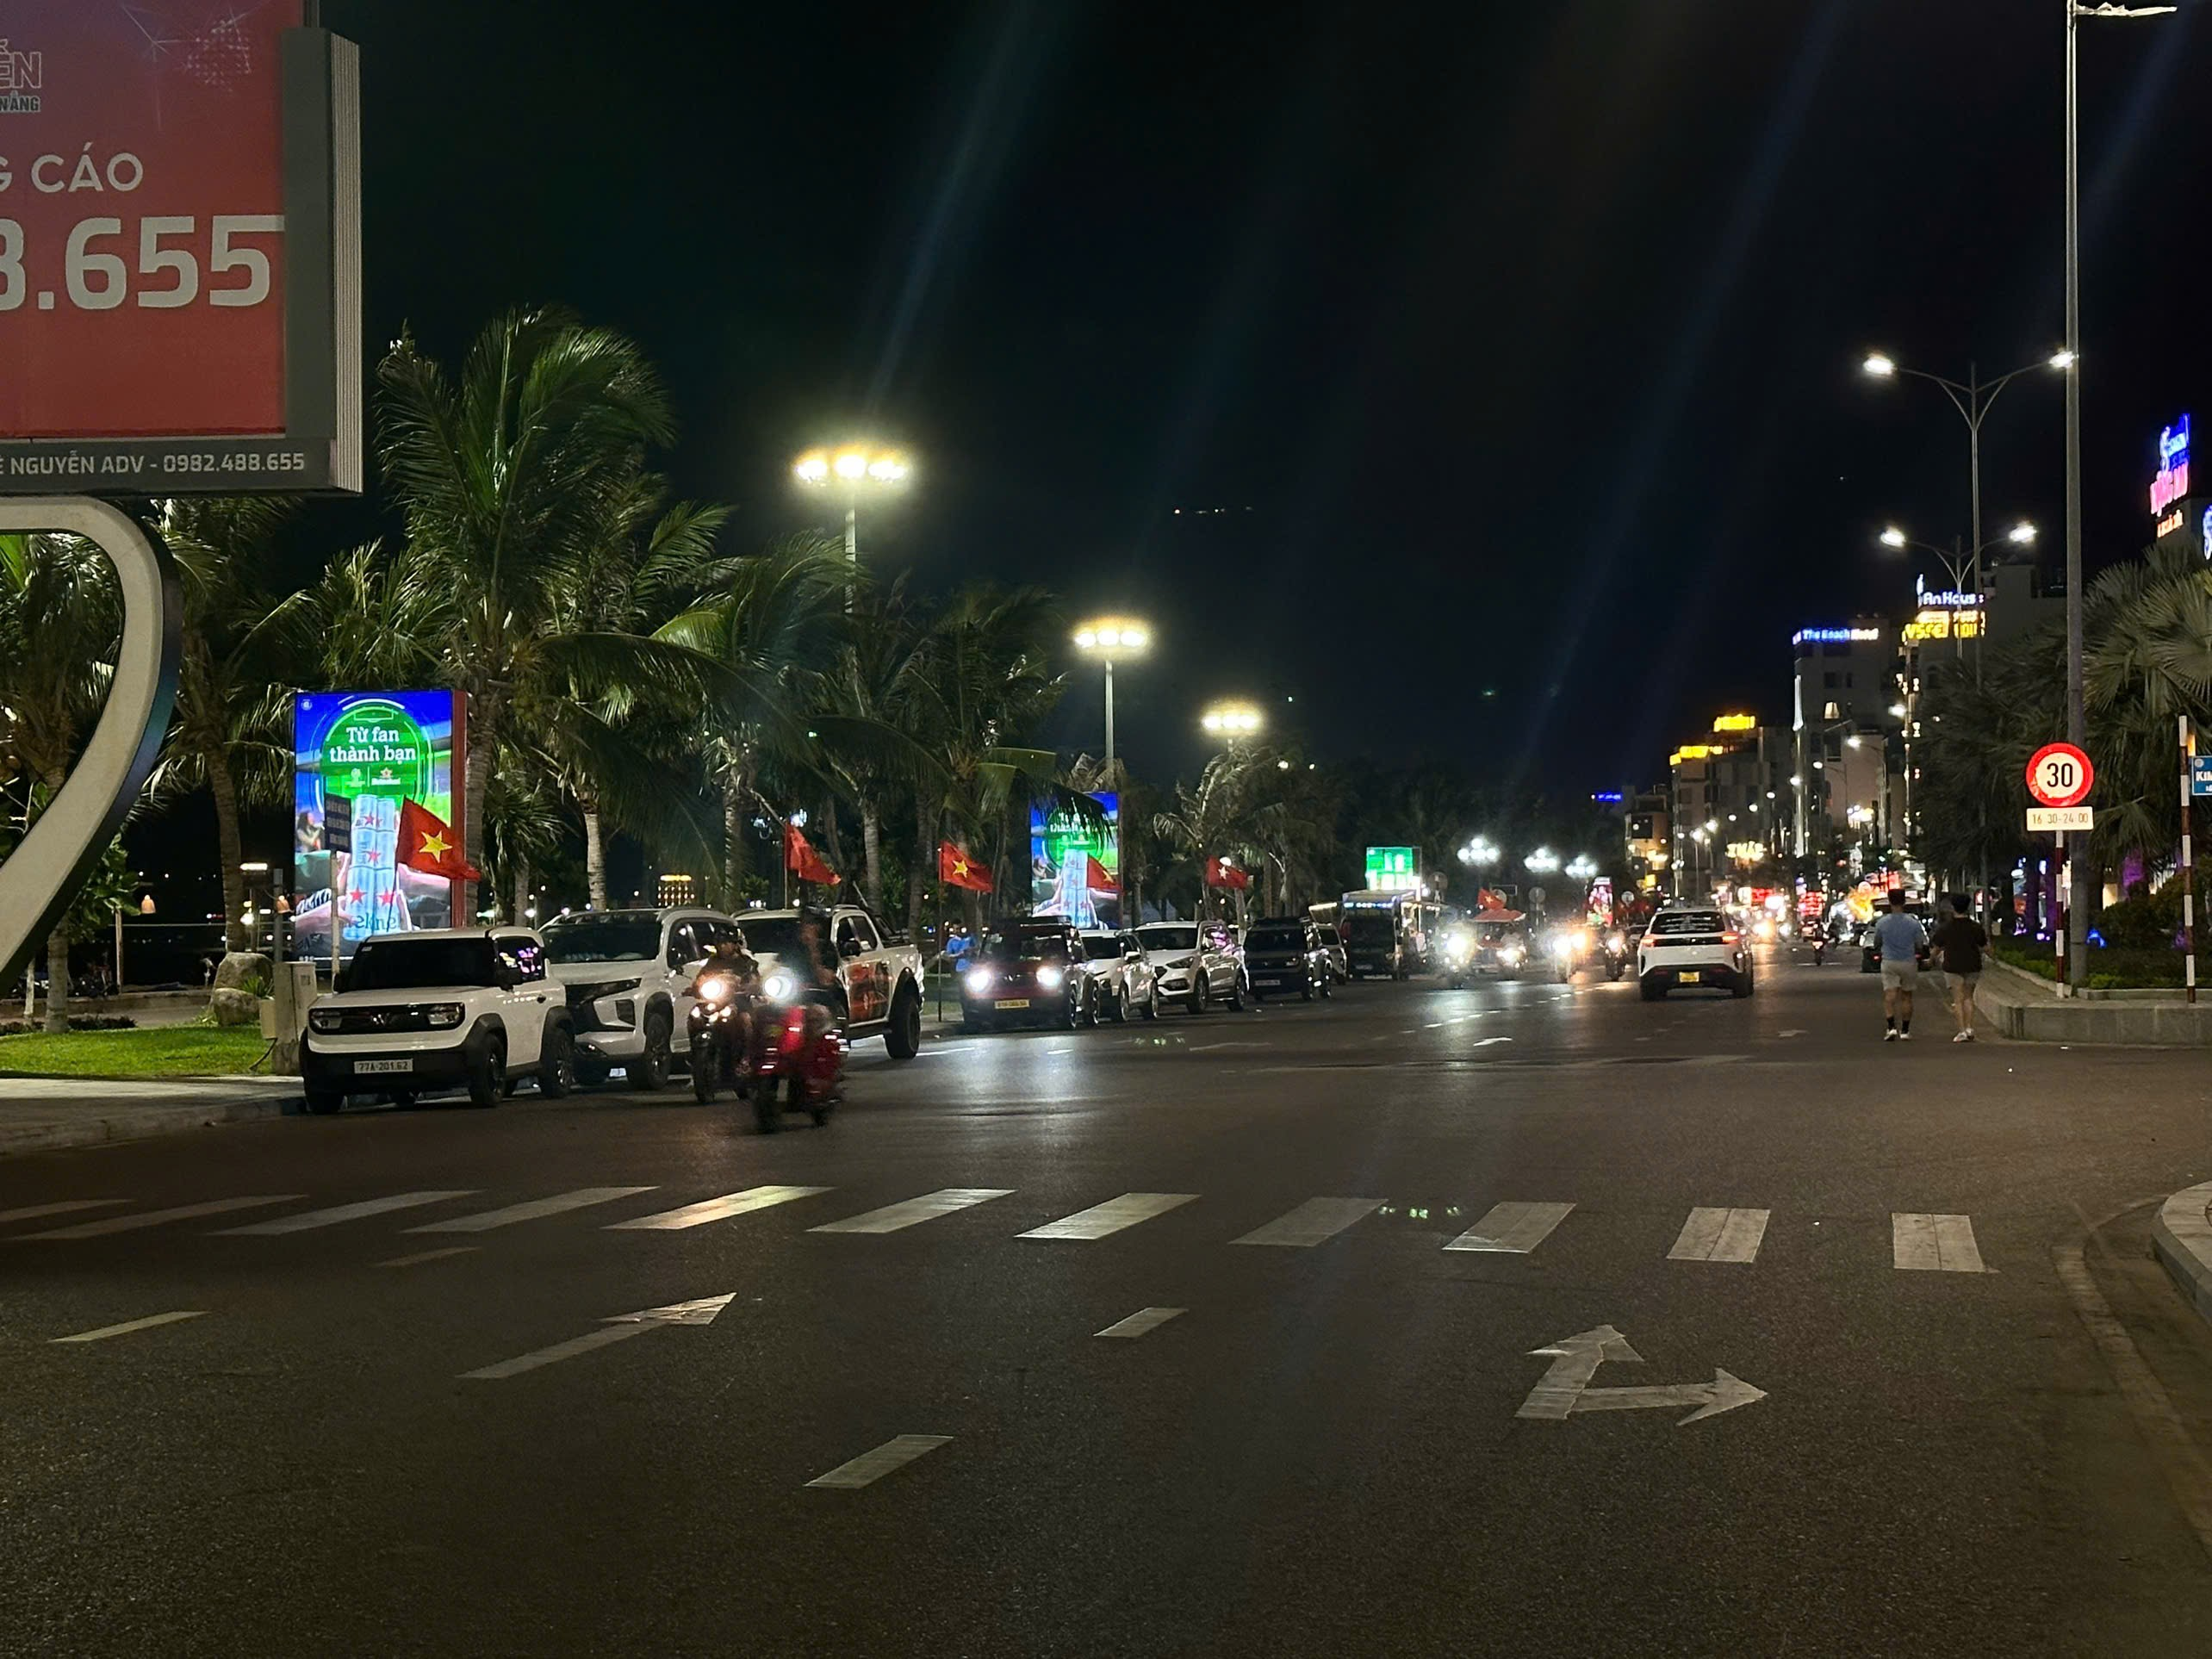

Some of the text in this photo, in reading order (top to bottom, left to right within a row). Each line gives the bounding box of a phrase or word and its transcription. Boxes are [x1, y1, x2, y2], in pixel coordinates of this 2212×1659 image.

[31, 141, 144, 193] CÁO
[10, 450, 95, 475] NGUYỄN
[101, 455, 145, 474] ADV
[164, 453, 304, 473] 0982.488.655
[345, 726, 400, 743] Từ fan
[330, 745, 416, 765] thành bạn
[2047, 762, 2073, 788] 30
